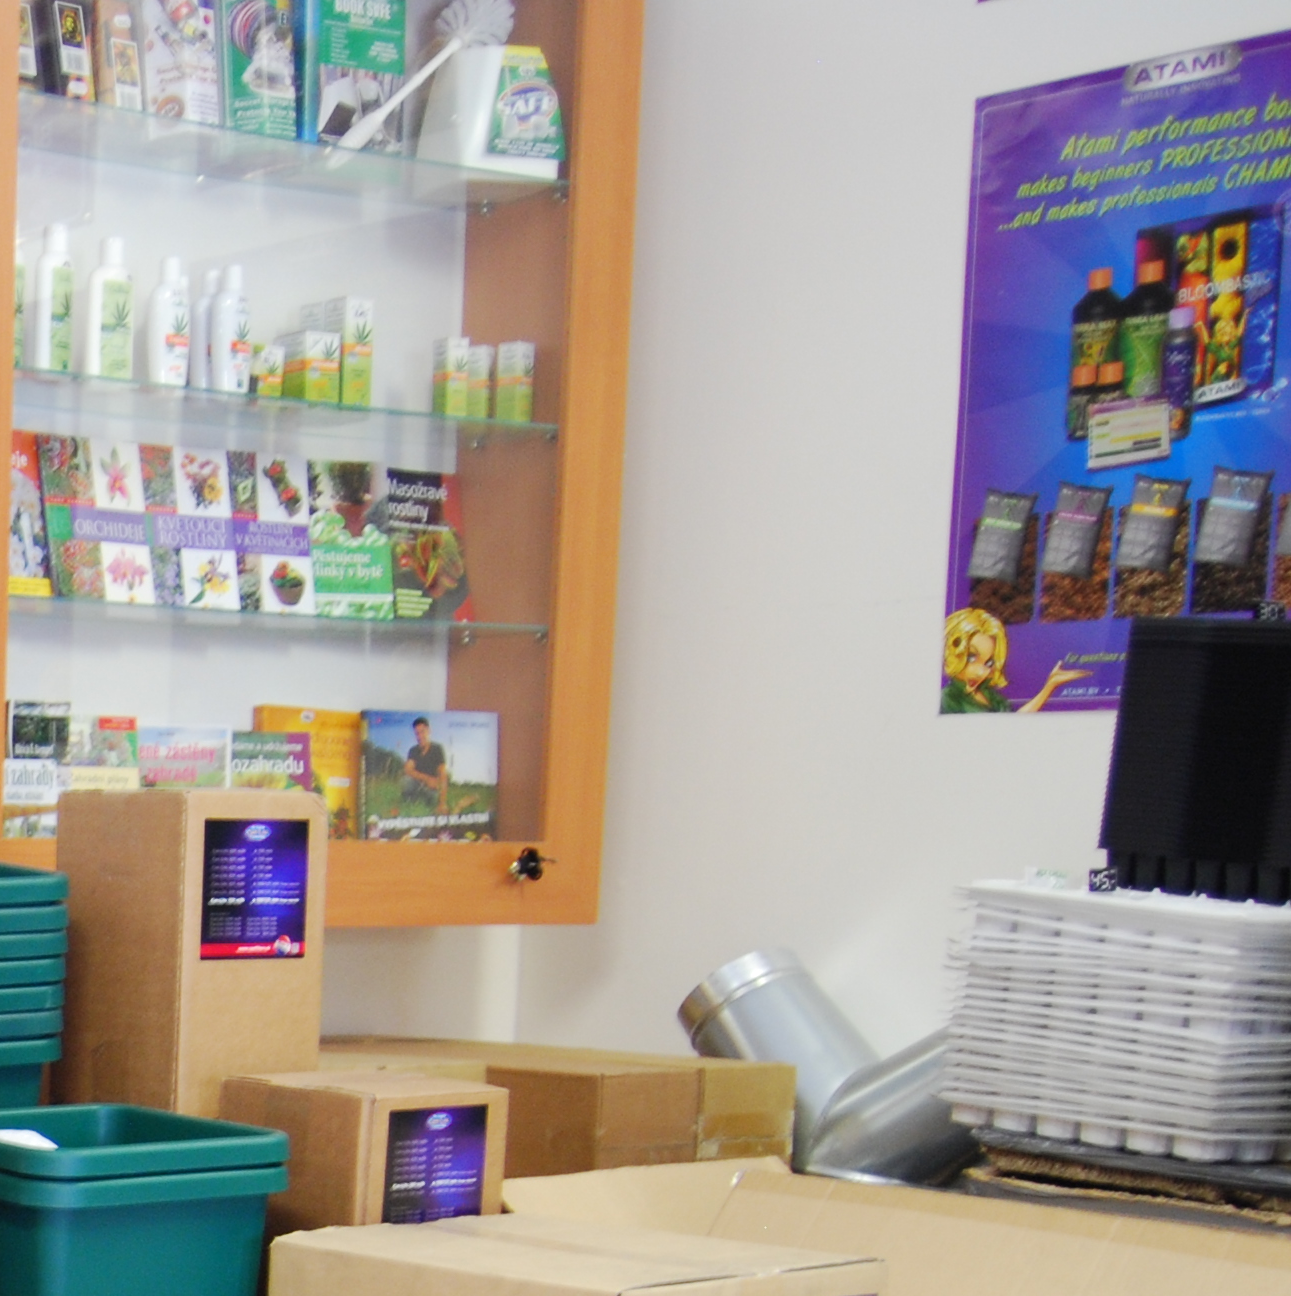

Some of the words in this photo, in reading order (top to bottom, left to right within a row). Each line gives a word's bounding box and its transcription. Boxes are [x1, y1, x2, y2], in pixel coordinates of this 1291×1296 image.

[1132, 52, 1226, 86] ATAMI
[1059, 130, 1121, 161] Atami
[1121, 106, 1259, 156] performance
[1016, 175, 1068, 199] makes
[1071, 159, 1154, 194] beginners
[1157, 126, 1291, 172] PROFESSION
[1045, 198, 1098, 222] makes
[1098, 174, 1219, 219] professionals
[1224, 156, 1291, 191] CHAM
[386, 476, 449, 502] Masožravé
[387, 502, 429, 523] rostliny
[73, 517, 146, 541] ORCHIDEJE
[159, 530, 228, 548] ROSTLINY
[232, 753, 305, 776] ozahradu
